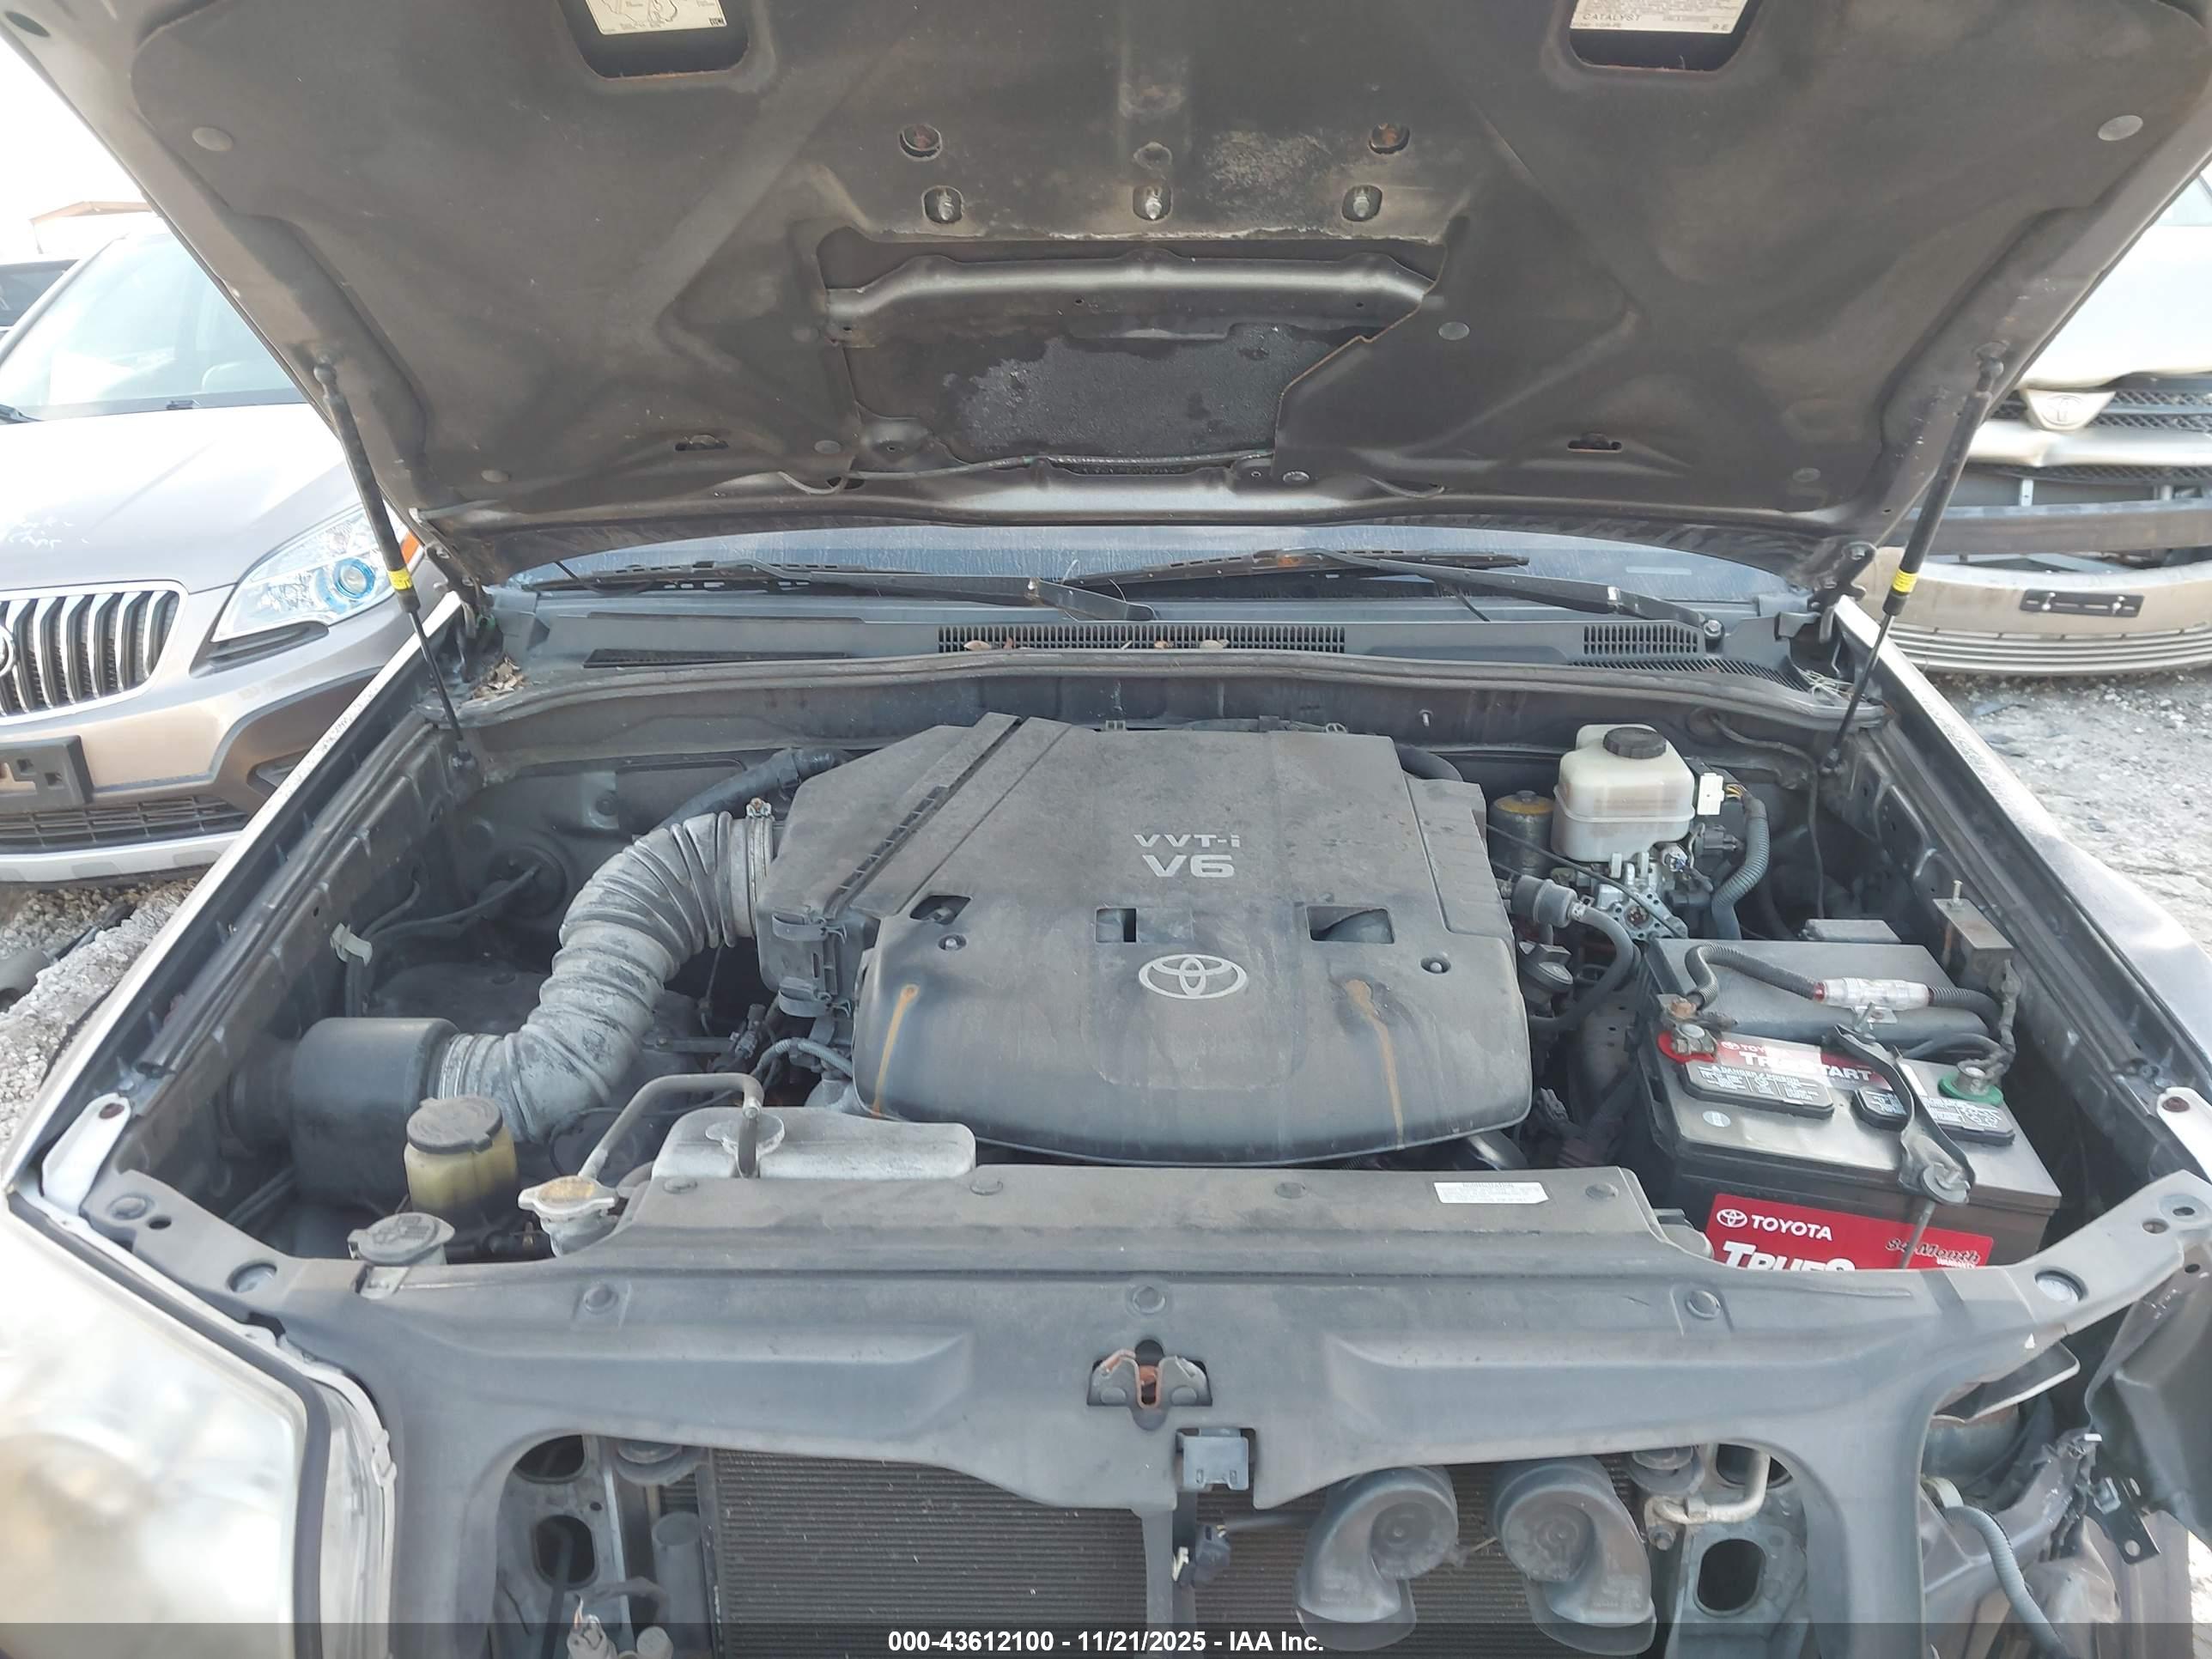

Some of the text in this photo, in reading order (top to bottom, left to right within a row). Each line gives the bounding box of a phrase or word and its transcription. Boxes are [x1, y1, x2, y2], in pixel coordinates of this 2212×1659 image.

[1582, 13, 1643, 21] CATALYST
[1133, 834, 1241, 848] VVT-i
[1141, 854, 1235, 878] V6
[1751, 1214, 1832, 1242] TOYOTA
[1914, 1242, 1981, 1265] Month
